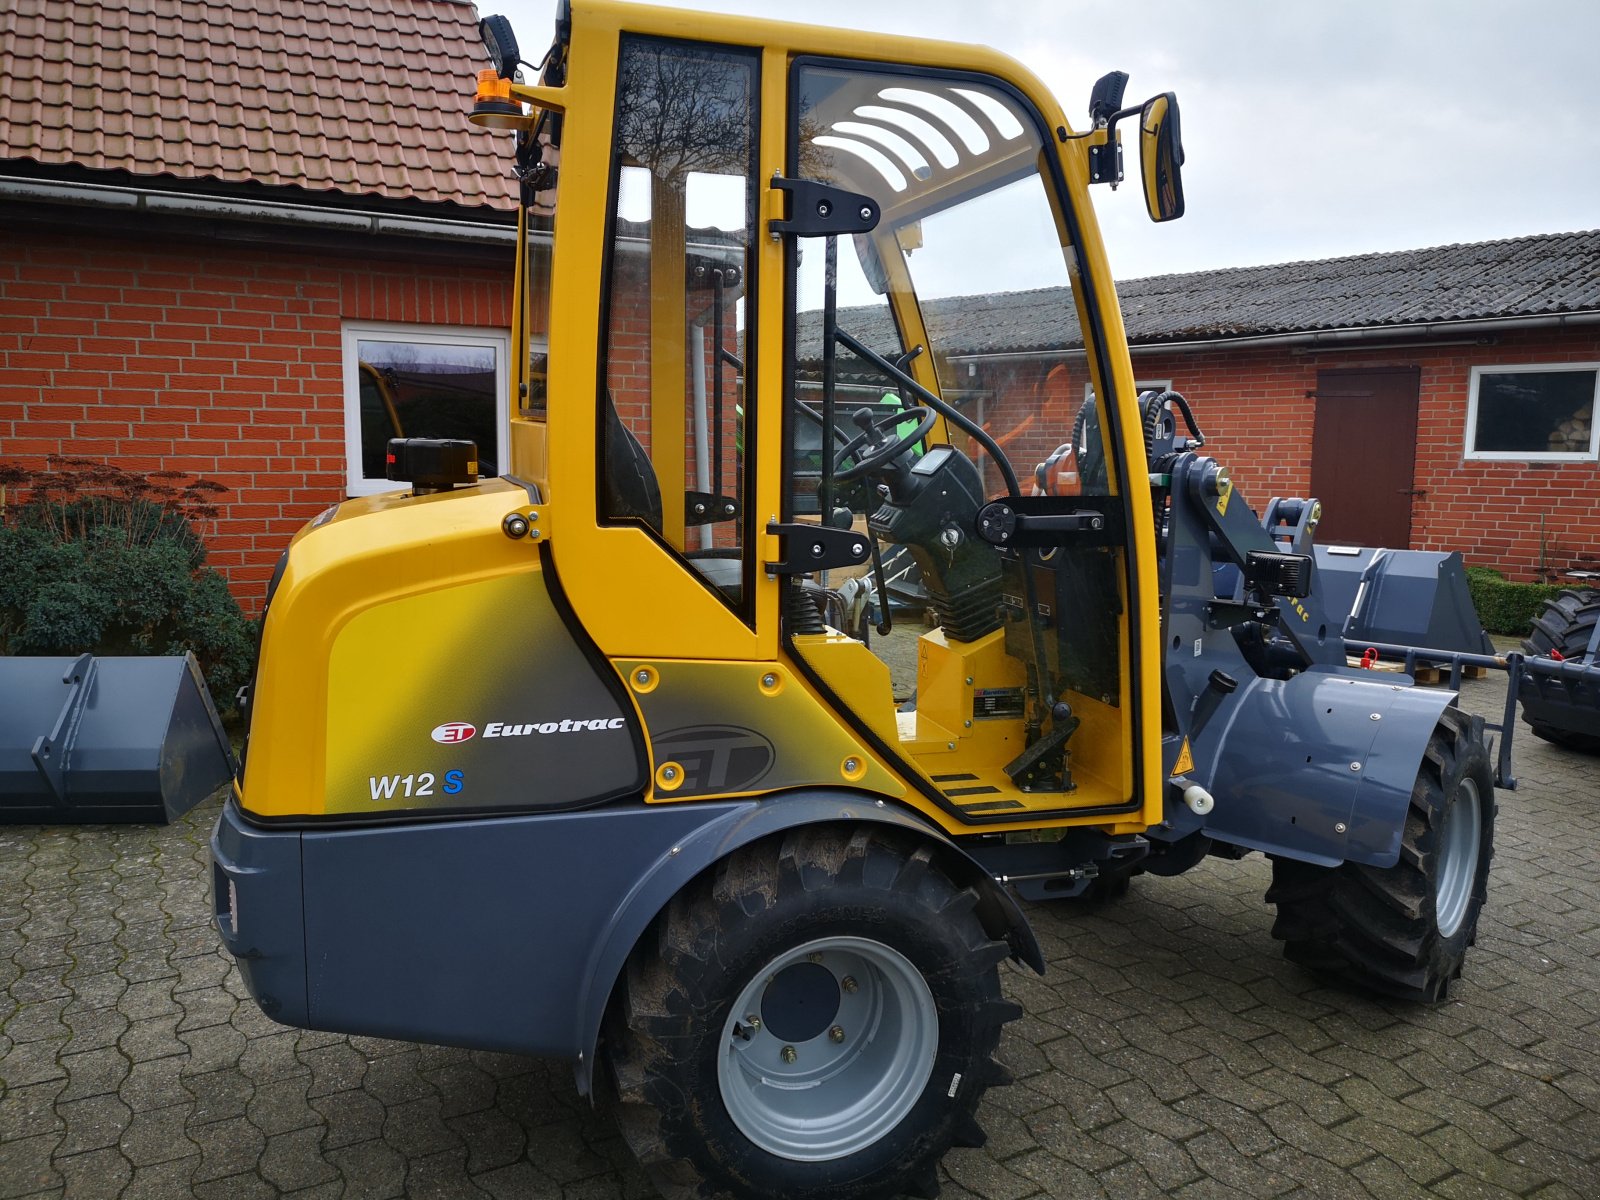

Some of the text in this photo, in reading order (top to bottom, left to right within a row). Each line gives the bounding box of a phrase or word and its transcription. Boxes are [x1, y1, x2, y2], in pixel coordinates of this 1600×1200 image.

[482, 717, 625, 738] Eurotrac
[369, 769, 464, 800] W12 S
